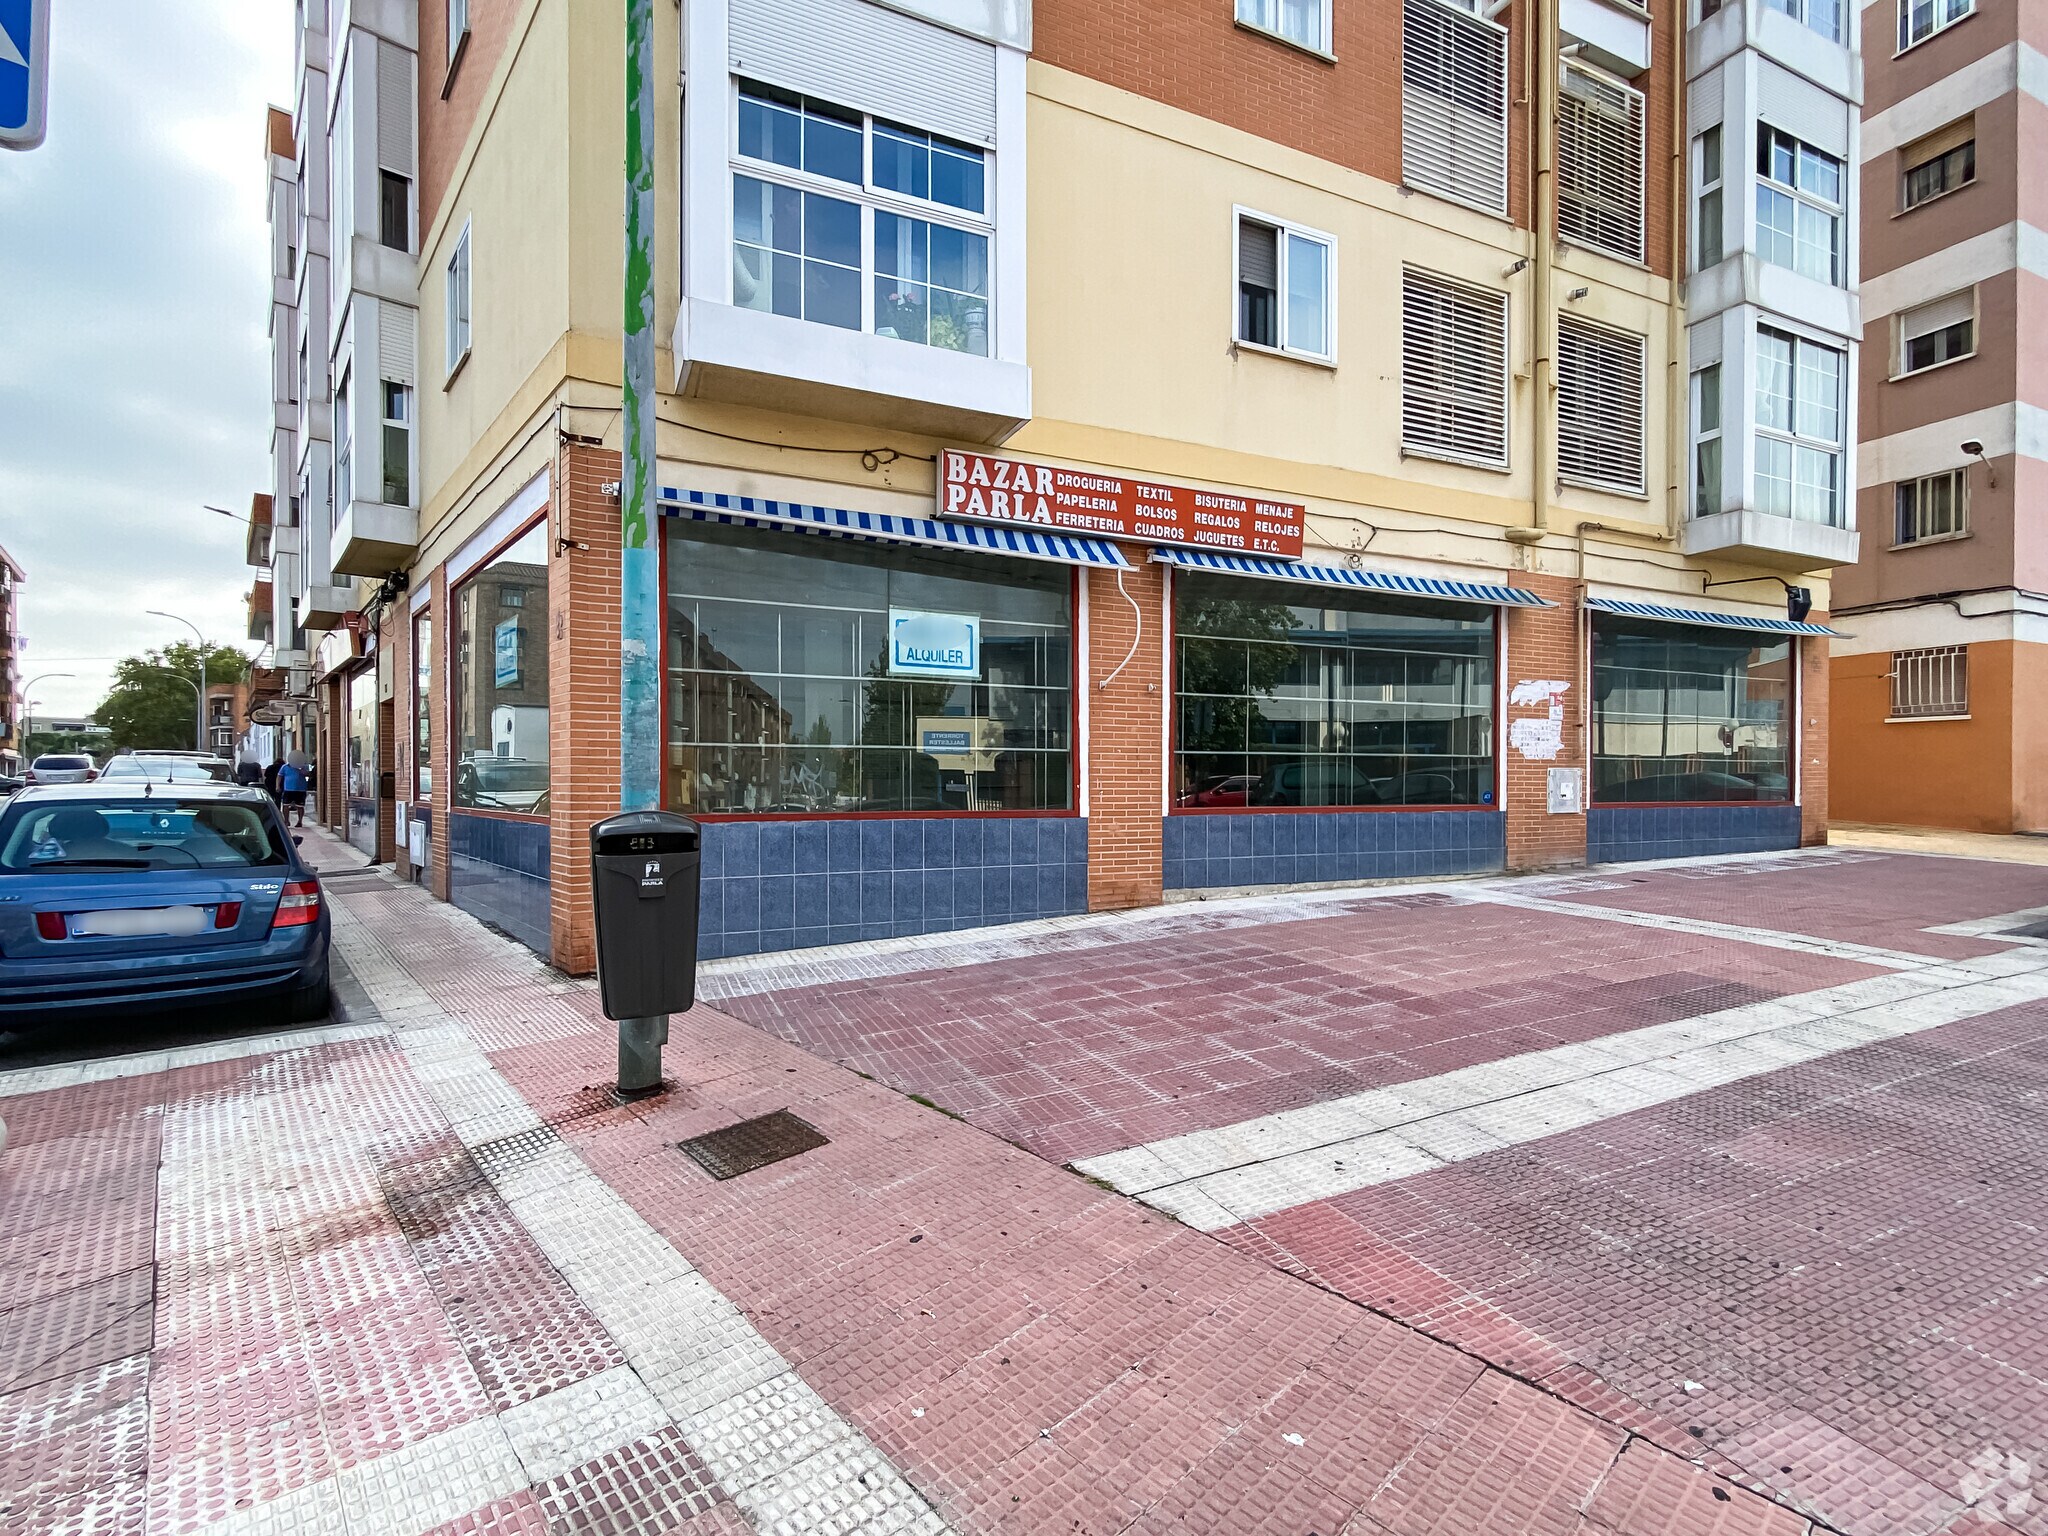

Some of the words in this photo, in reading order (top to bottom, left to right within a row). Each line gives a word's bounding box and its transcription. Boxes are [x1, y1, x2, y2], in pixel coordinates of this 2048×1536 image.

[947, 453, 1055, 496] BAZAR
[947, 484, 1053, 524] PARLA
[1056, 473, 1123, 494] DROGUERIA
[1136, 485, 1174, 502] TEXTIL
[1195, 494, 1247, 512] BISUTERIA
[1255, 503, 1294, 519] MENAJE
[1056, 492, 1118, 512] PAPELERIA
[1135, 504, 1177, 521] BOLSOS
[1194, 512, 1240, 529] REGALOS
[1254, 520, 1300, 537] RELOJES
[1055, 511, 1125, 532] FERRETERIA
[1134, 522, 1185, 540] CUADROS
[1193, 530, 1245, 547] JUGUETES
[1253, 538, 1280, 551] E.T.C.
[906, 647, 963, 664] ALQUILER
